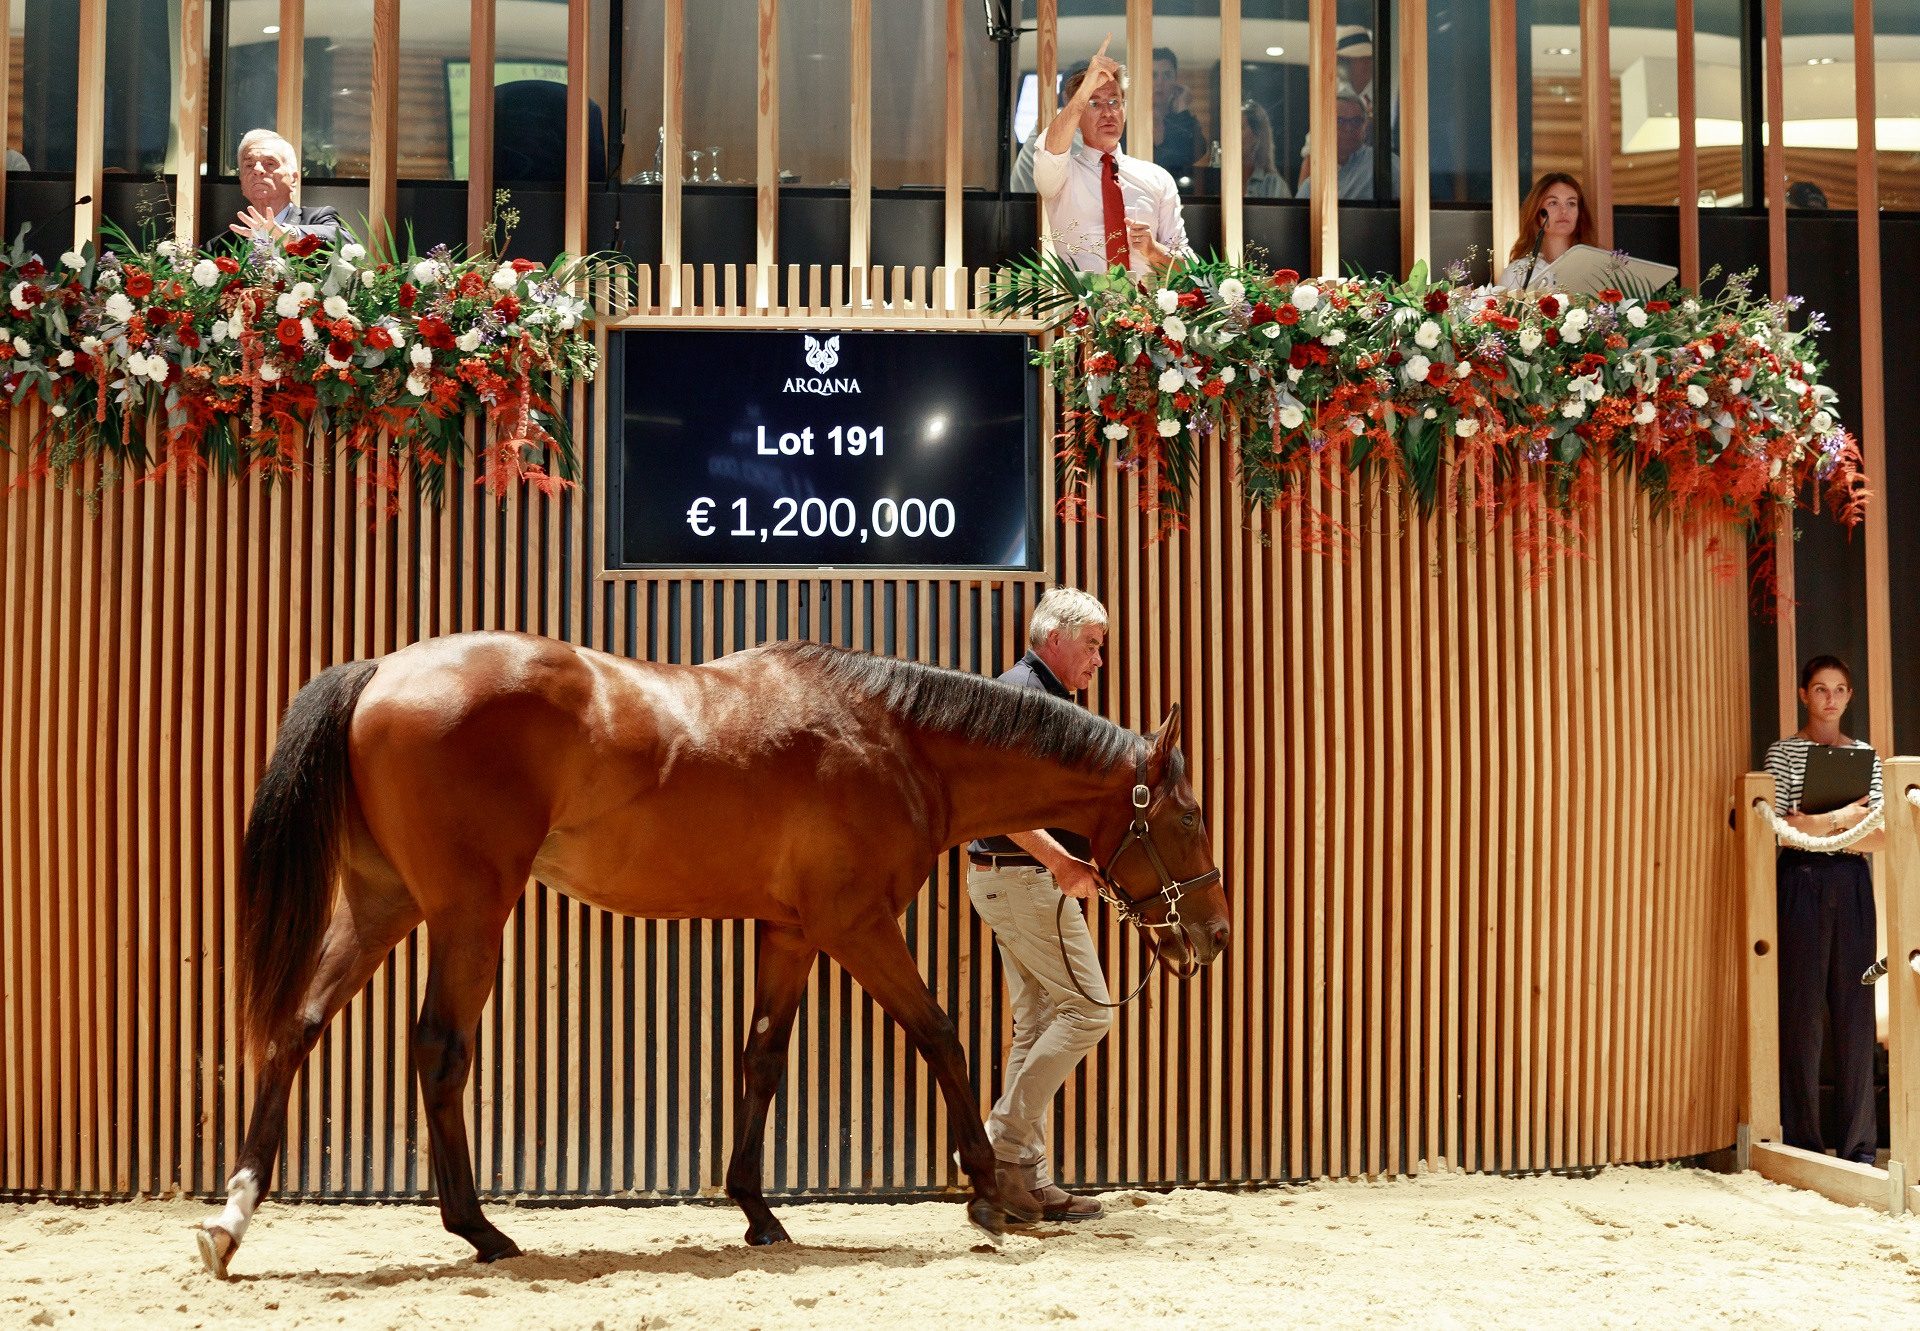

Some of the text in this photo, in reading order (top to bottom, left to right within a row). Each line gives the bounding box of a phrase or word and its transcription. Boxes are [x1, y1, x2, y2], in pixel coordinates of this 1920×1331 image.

[783, 378, 861, 396] ARQANA
[757, 425, 883, 455] Lot 191
[686, 497, 955, 543] € 1,200,000
